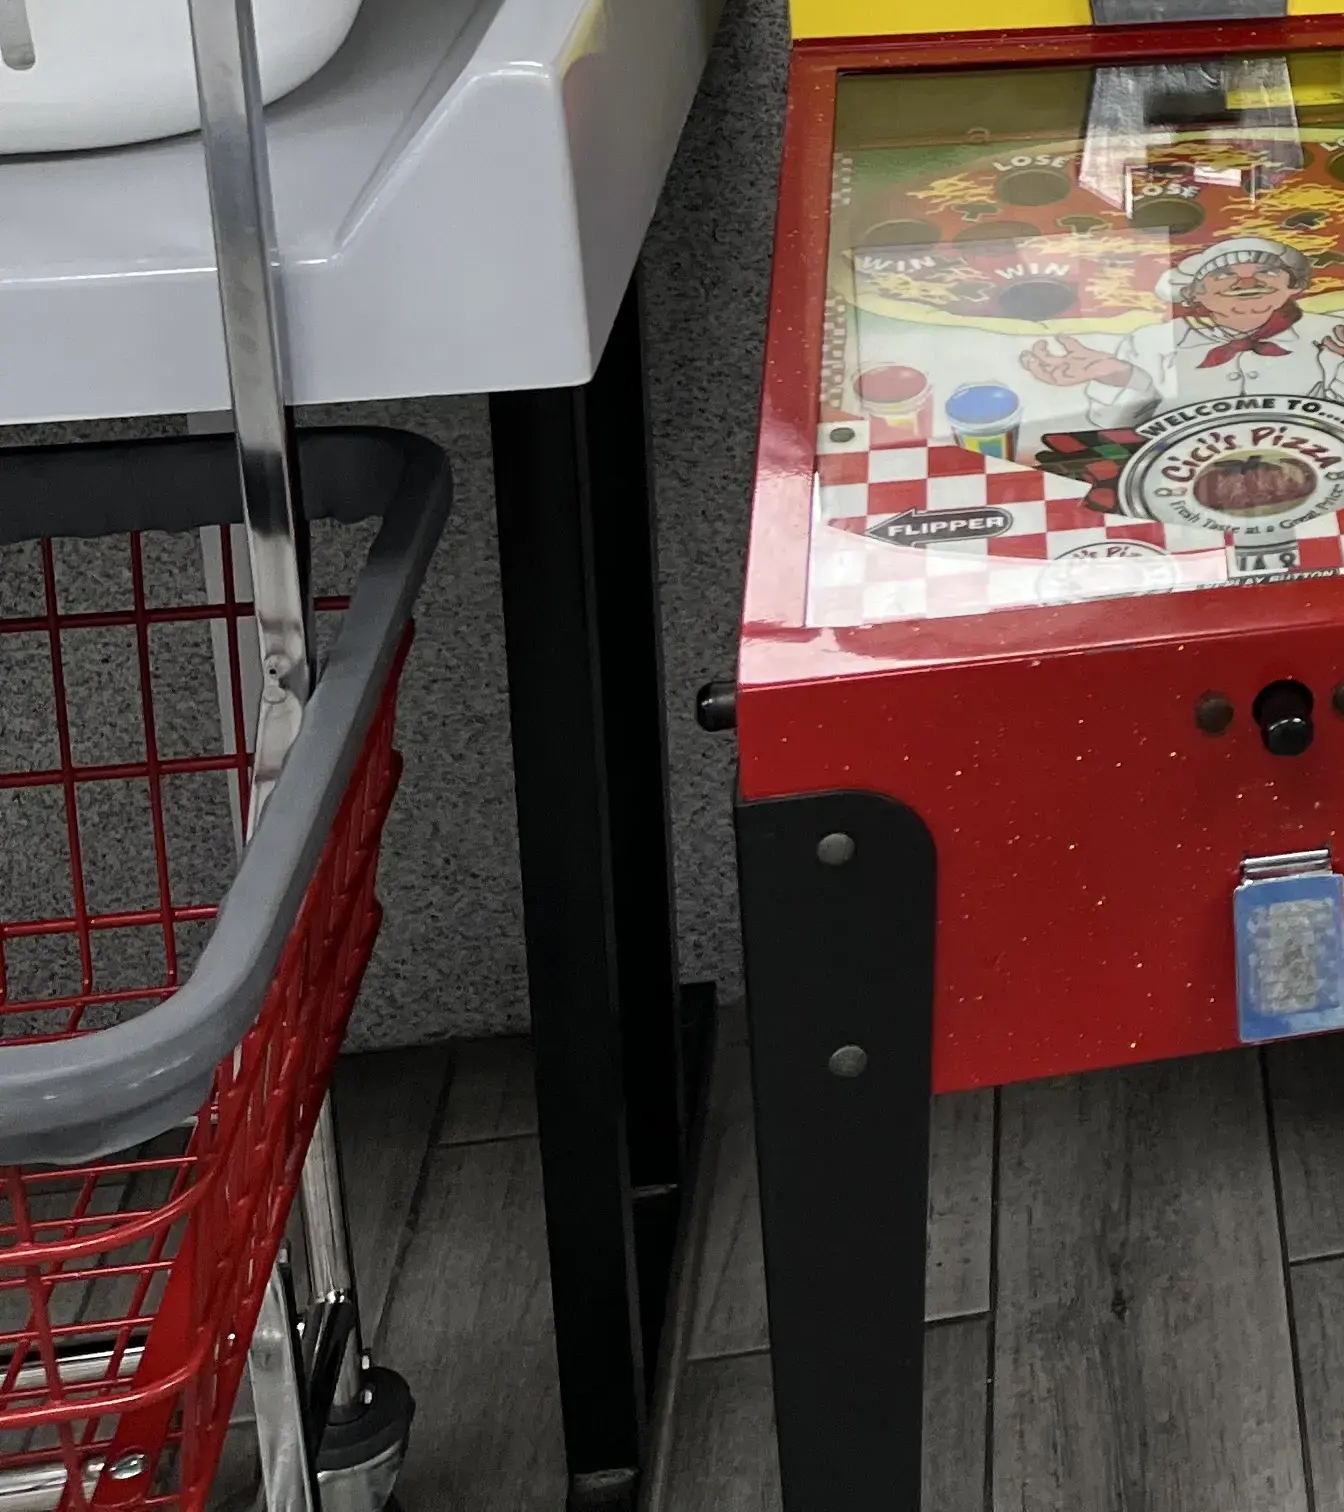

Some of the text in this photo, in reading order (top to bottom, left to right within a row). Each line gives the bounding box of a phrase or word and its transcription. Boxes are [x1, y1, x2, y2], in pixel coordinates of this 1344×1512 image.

[993, 154, 1071, 172] LOSE
[863, 255, 936, 273] WIN
[995, 262, 1072, 280] WIN
[1139, 398, 1276, 438] WELCOME
[887, 514, 1005, 538] FLIPPER
[1169, 499, 1200, 524] Fresh
[1204, 517, 1241, 534] Taste
[1244, 525, 1261, 535] at
